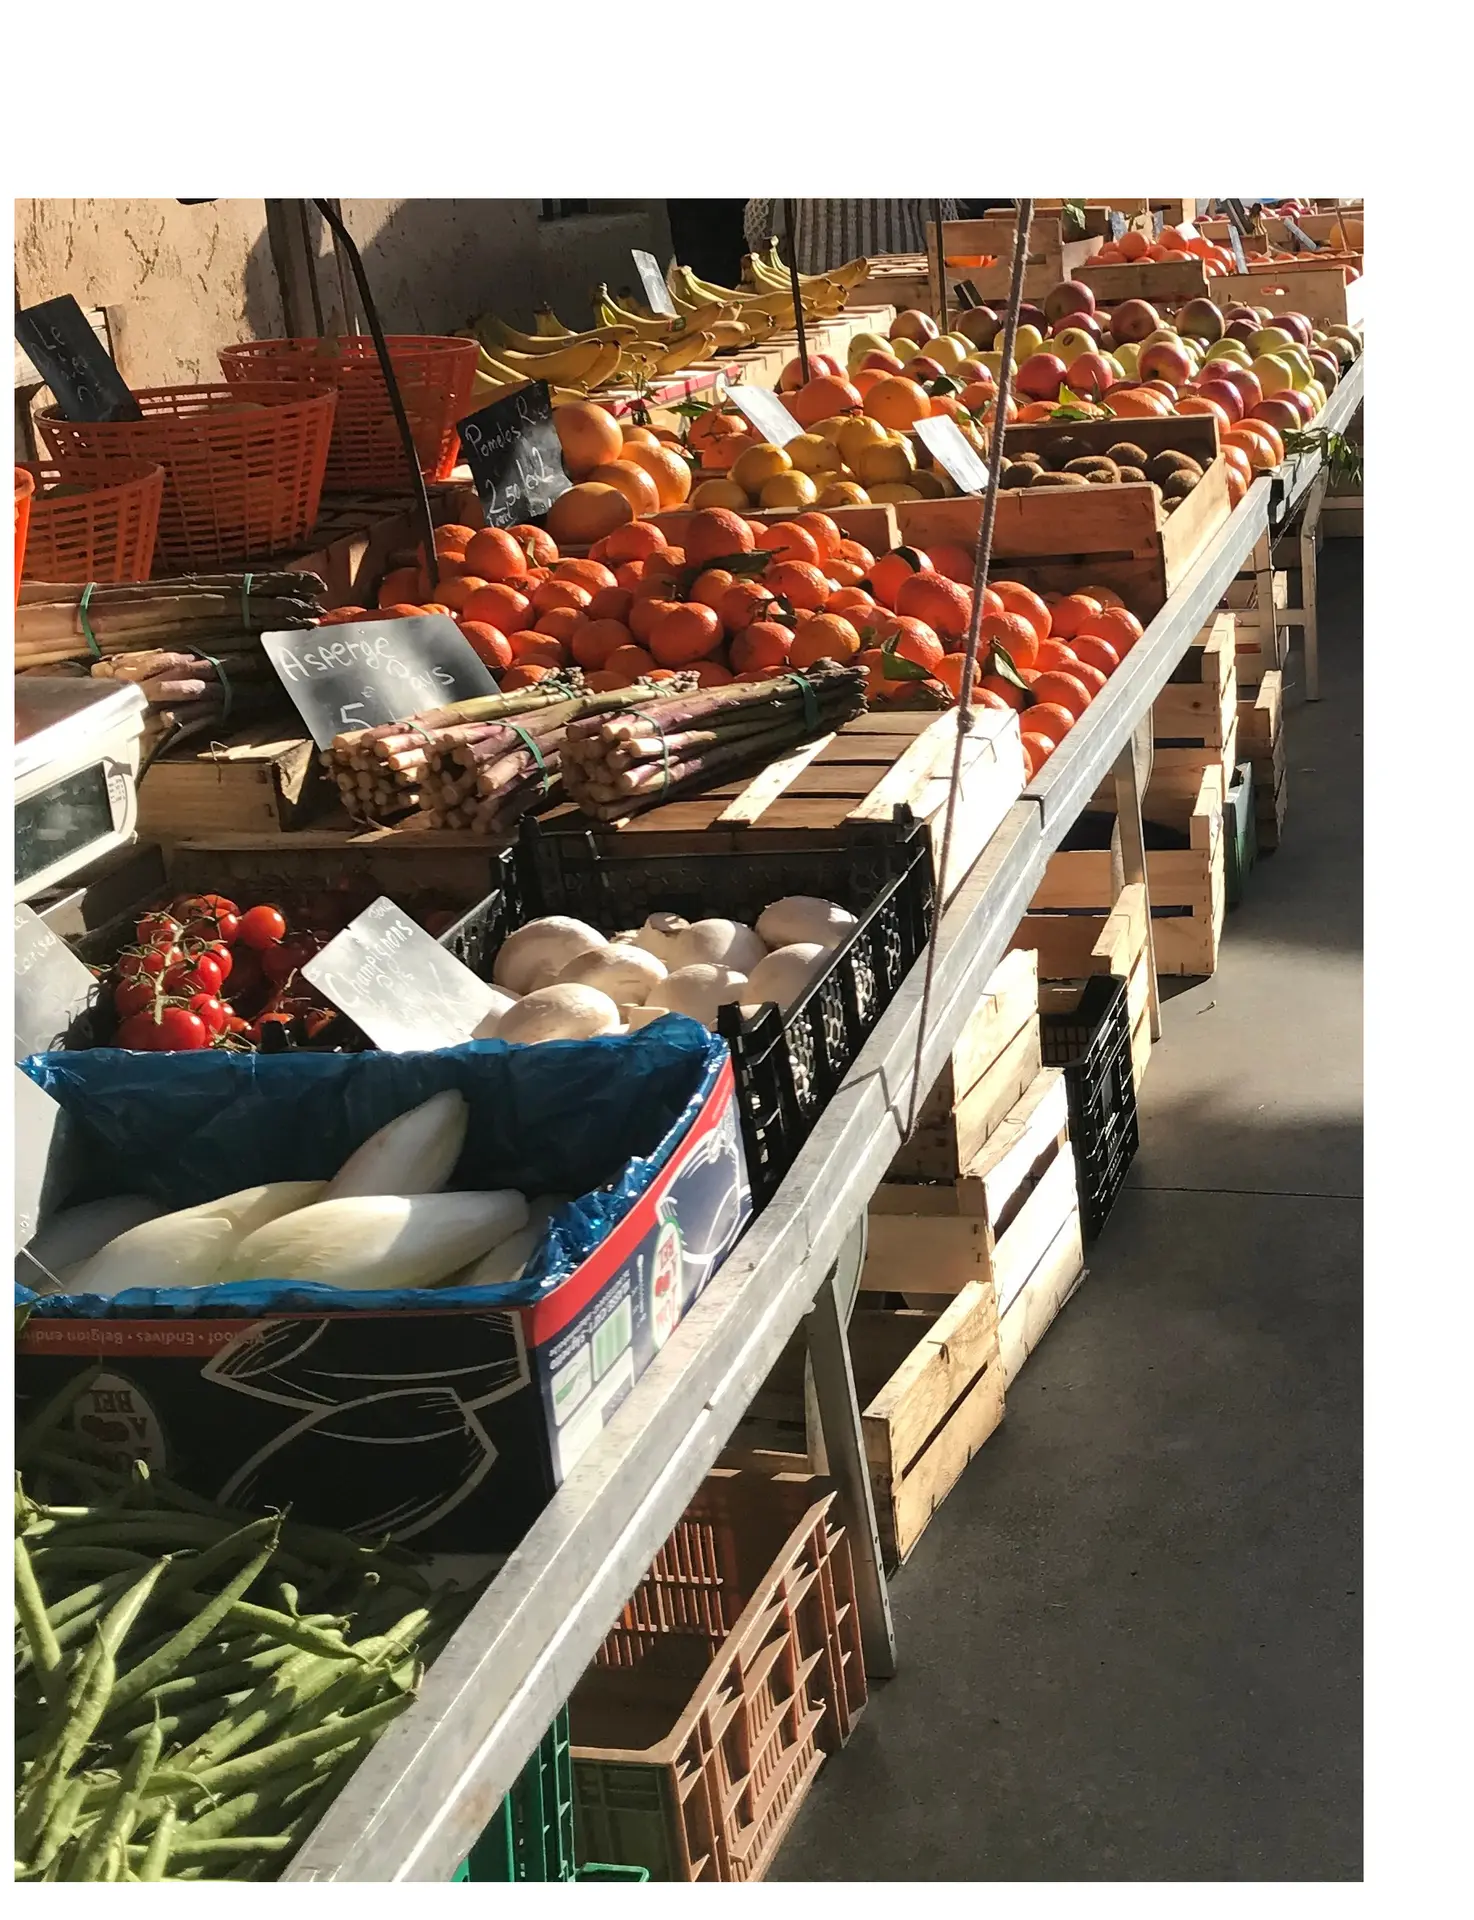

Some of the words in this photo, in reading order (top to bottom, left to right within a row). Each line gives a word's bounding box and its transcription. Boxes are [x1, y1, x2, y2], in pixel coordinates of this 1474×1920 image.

[464, 422, 522, 462] Pomelos
[279, 636, 396, 681] Asperge
[324, 919, 413, 1008] Champignons
[66, 1329, 124, 1346] Belgian
[136, 1331, 194, 1346] Endives
[90, 1390, 135, 1414] BEL
